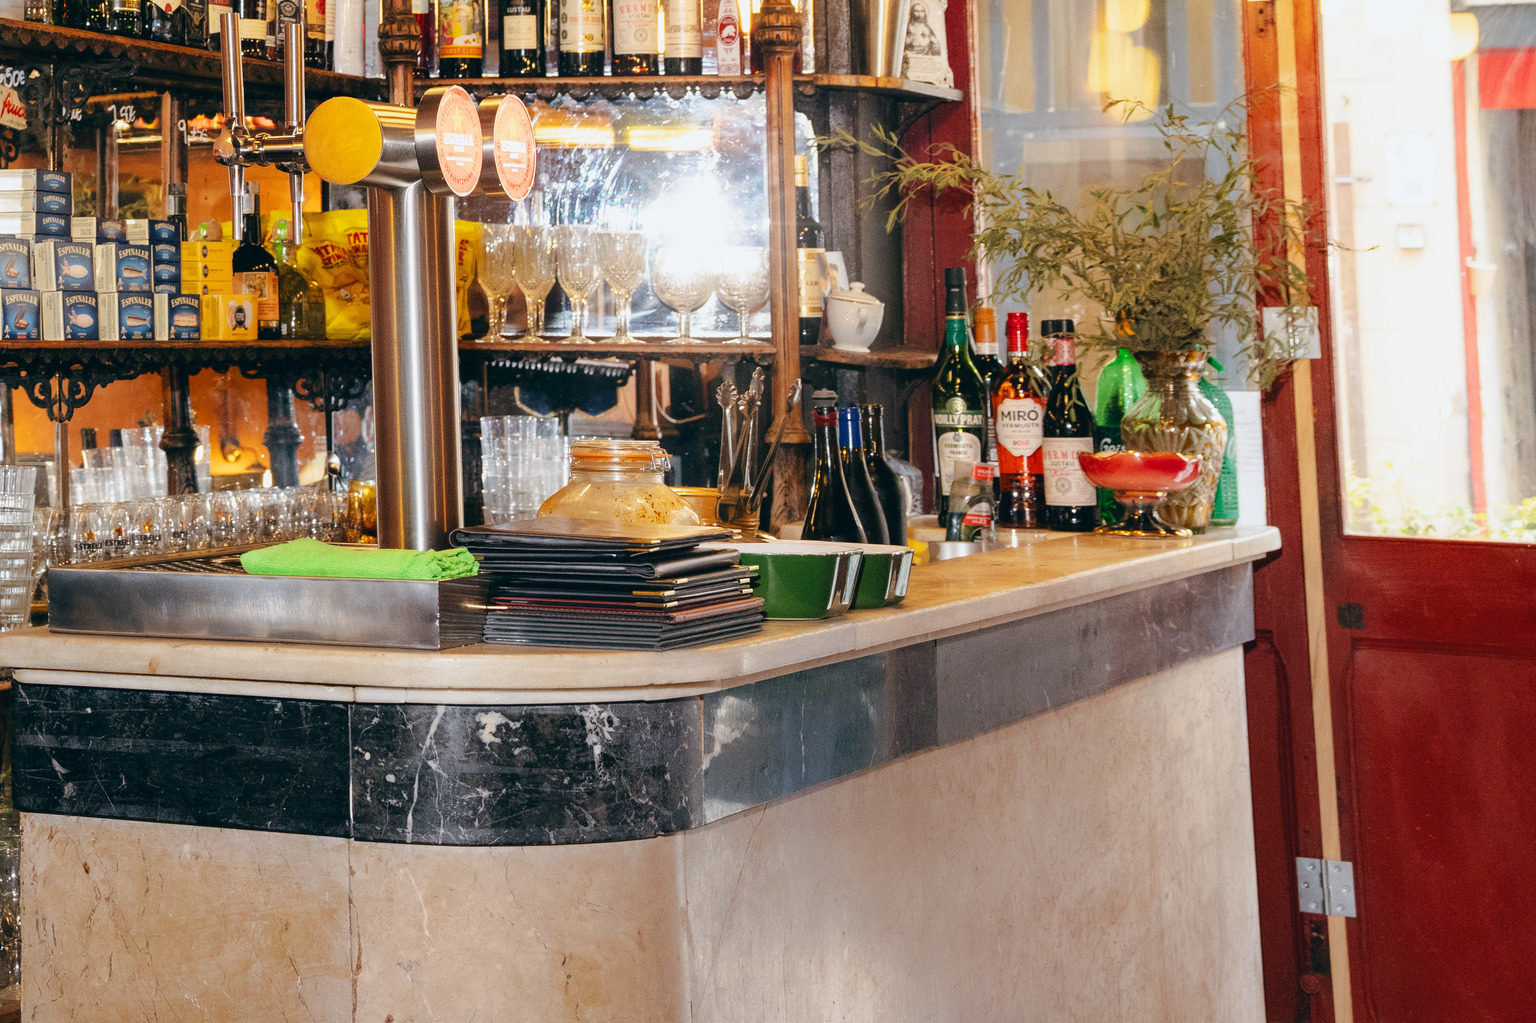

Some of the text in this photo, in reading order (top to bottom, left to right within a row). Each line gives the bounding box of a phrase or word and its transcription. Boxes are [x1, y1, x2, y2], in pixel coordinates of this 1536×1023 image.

[57, 246, 91, 258] ESPINALER
[118, 248, 150, 260] ESPINALER
[5, 294, 39, 307] ESPINALER
[66, 296, 97, 307] ESPINALER
[121, 296, 152, 308] ESPINALER
[171, 297, 199, 308] ESPINALER
[960, 414, 983, 425] PRAT
[1001, 407, 1039, 422] MIRÓ
